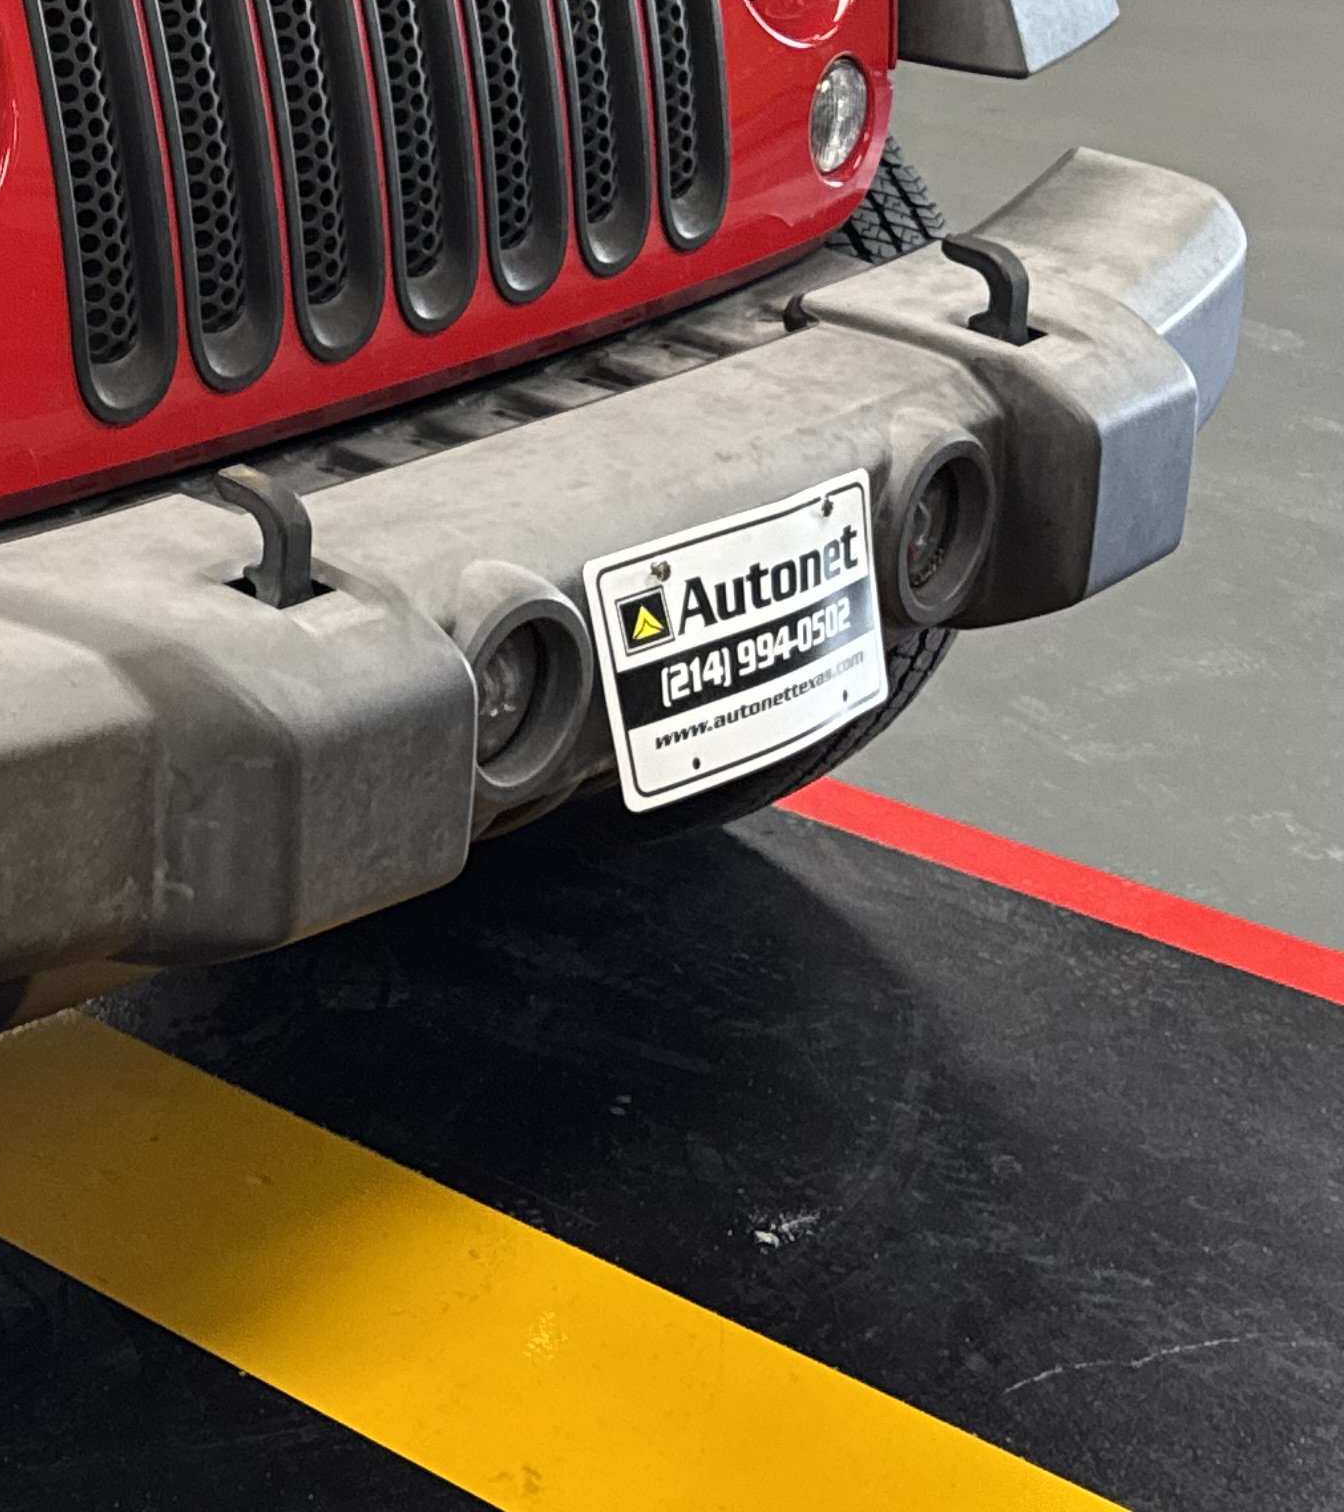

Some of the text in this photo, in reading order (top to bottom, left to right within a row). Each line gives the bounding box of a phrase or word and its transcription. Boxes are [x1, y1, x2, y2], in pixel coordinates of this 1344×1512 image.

[677, 524, 859, 636] Autonet
[655, 650, 865, 750] www.autonettexas.com
[661, 596, 851, 708] (214) 994-0502
